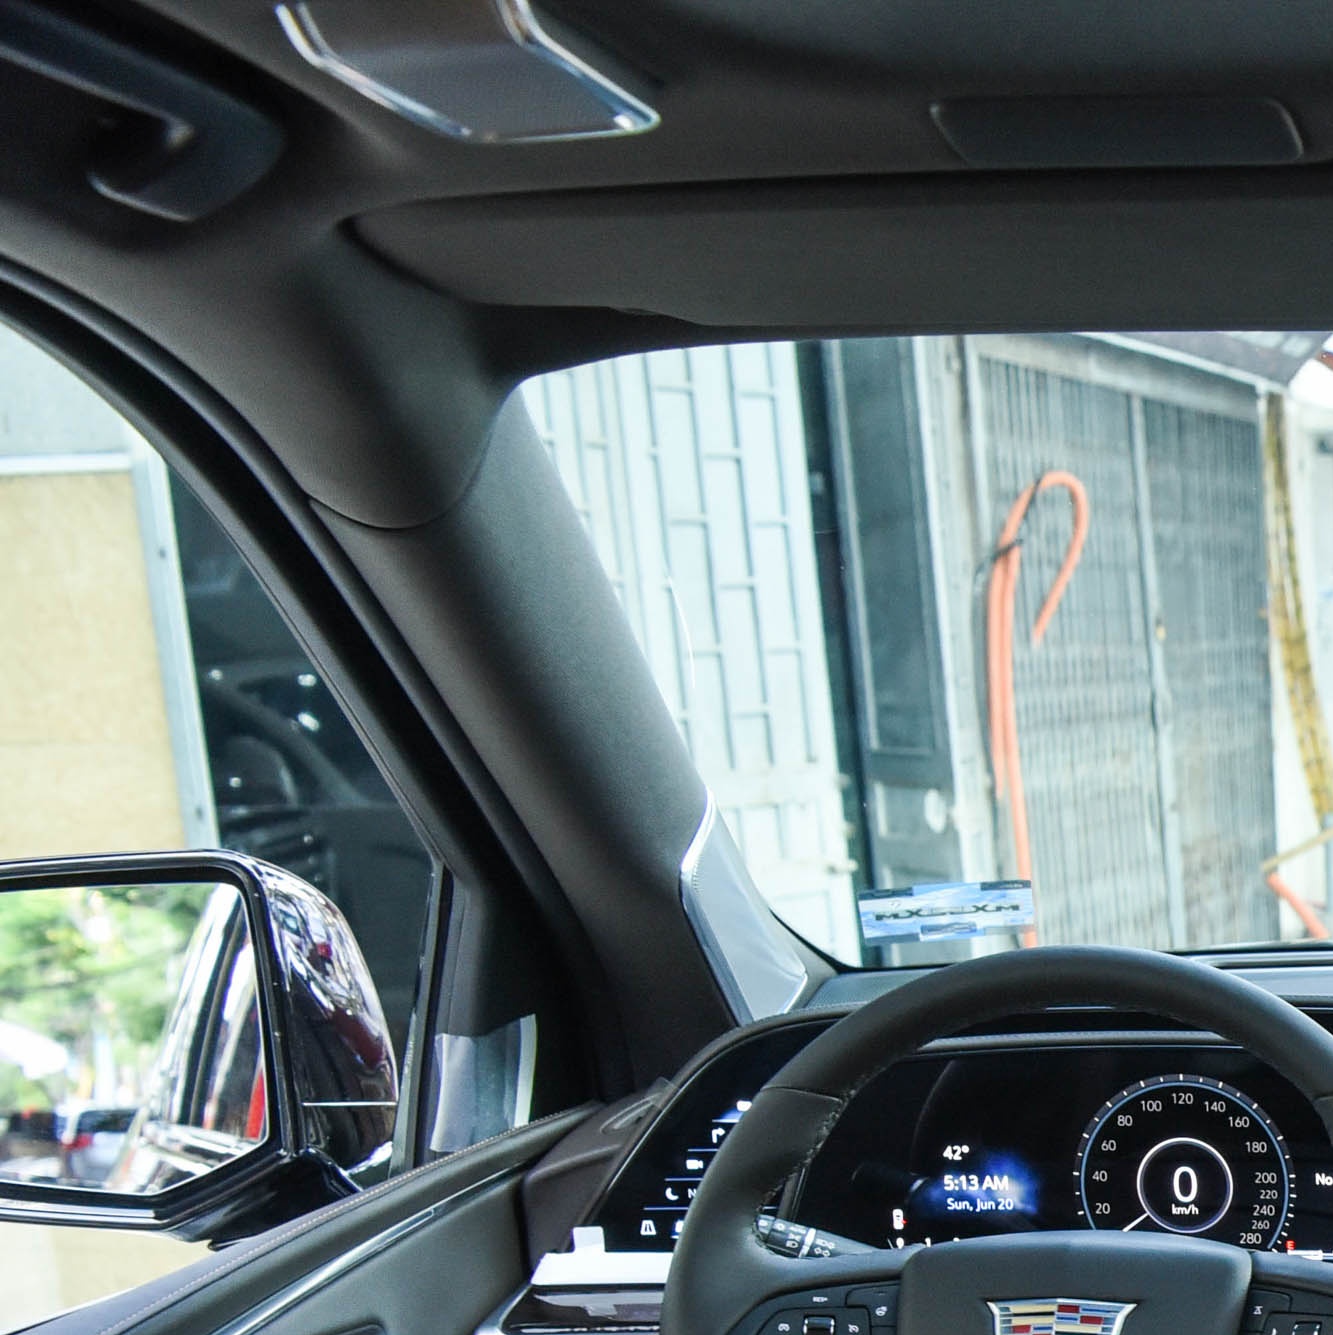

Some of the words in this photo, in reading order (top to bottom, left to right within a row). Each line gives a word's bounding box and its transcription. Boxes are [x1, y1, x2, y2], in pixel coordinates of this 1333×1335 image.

[1171, 1093, 1194, 1105] 120
[1140, 1101, 1162, 1112] 100
[1204, 1101, 1226, 1113] 140
[1117, 1115, 1133, 1127] 80
[1228, 1117, 1250, 1128] 160
[1101, 1140, 1117, 1152] 60
[1245, 1142, 1267, 1153] 180
[943, 1145, 970, 1161] 42°
[943, 1174, 981, 1191] 5:13
[982, 1174, 1009, 1191] AM
[1092, 1171, 1108, 1183] 40
[1254, 1172, 1277, 1184] 200
[1315, 1173, 1333, 1186] No
[1172, 1166, 1198, 1203] 0
[1259, 1189, 1278, 1200] 220
[947, 1198, 974, 1211] Sun,
[975, 1198, 996, 1211] Jun
[998, 1198, 1014, 1210] 20
[1095, 1203, 1111, 1214] 20
[1171, 1203, 1199, 1215] km/h
[1253, 1205, 1275, 1217] 240
[1251, 1220, 1270, 1230] 260
[1239, 1233, 1262, 1245] 280
[1287, 1241, 1295, 1250] E
